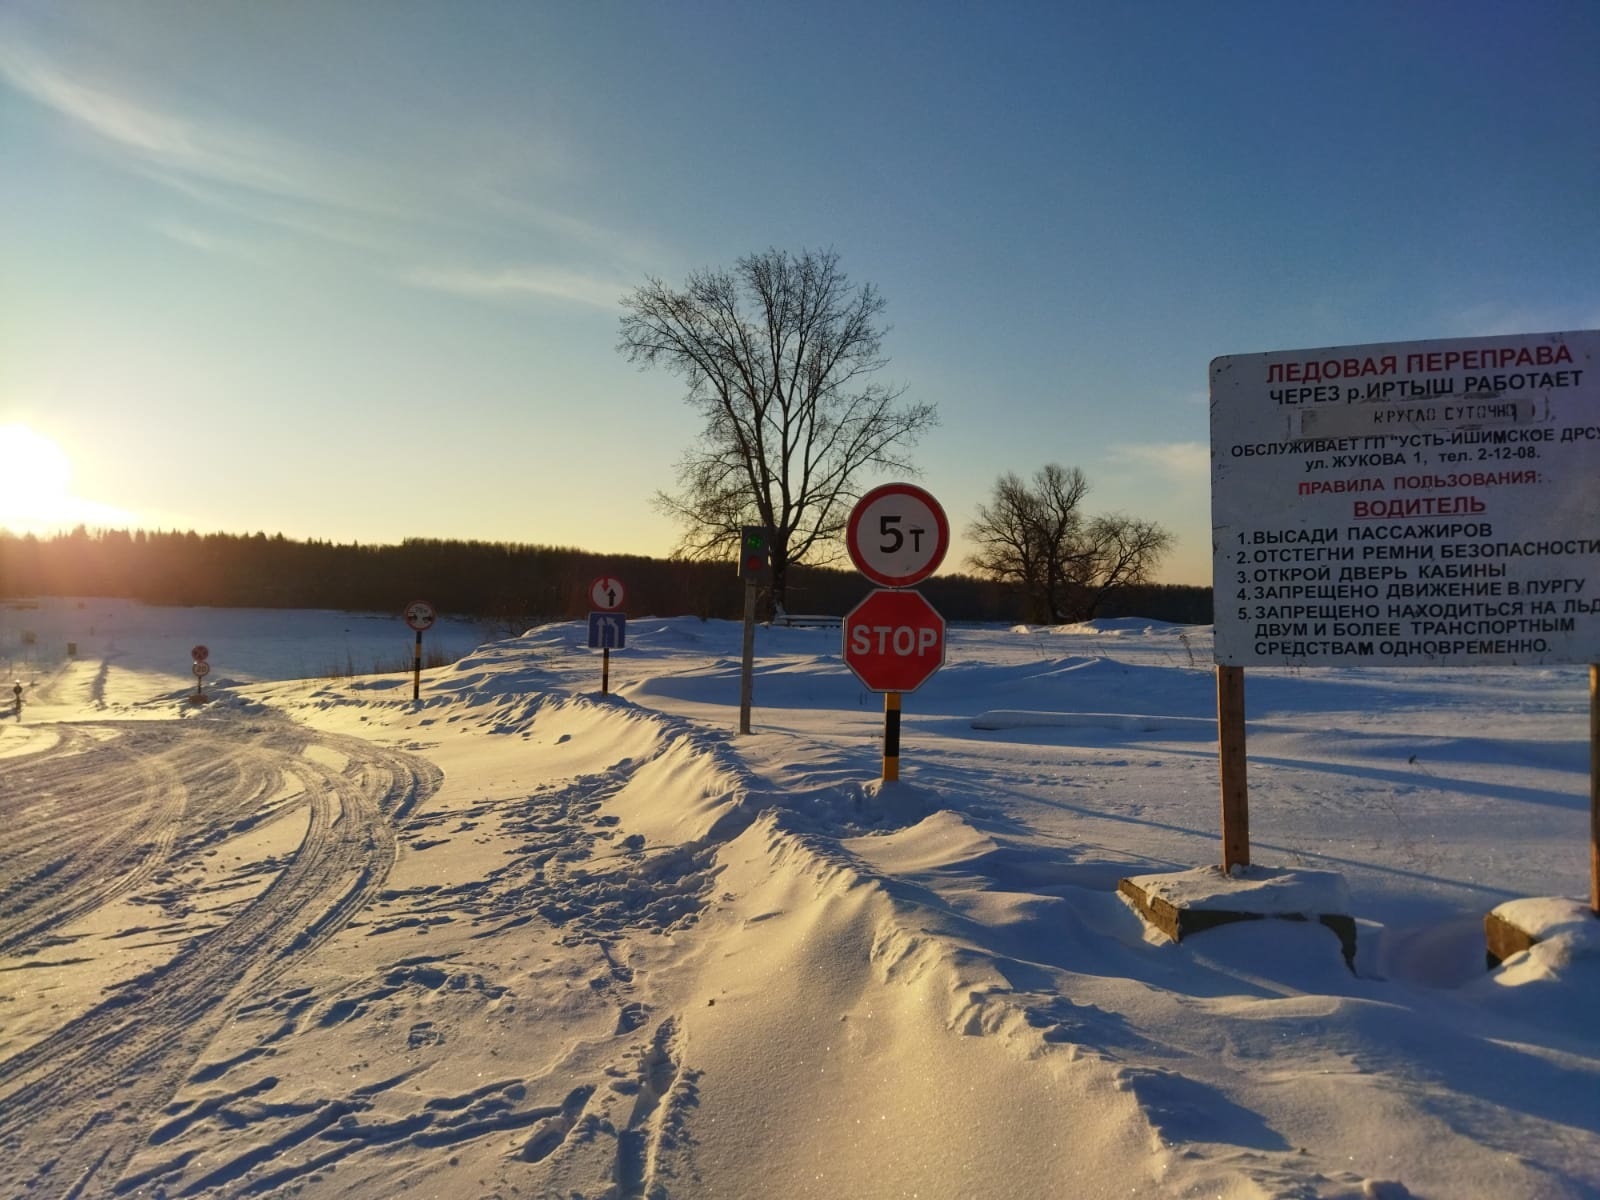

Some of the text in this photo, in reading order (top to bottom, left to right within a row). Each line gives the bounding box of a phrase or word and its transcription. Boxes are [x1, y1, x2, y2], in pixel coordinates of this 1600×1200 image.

[1266, 344, 1573, 384] ЛЕДОВАЯ ПЕРЕПРАВА
[1270, 385, 1340, 404] ЧЕРЕЗ
[1464, 370, 1583, 393] РАБОТАЕТ
[1231, 438, 1357, 457] ОБСЛУЖИВАЕТ
[1440, 452, 1472, 463] тел.
[1478, 446, 1541, 461] 2-12-08.
[1298, 471, 1543, 496] ПРАВИЛА ПОЛЬЗОВАНИЯ:
[1354, 496, 1486, 519] ВОДИТЕЛЬ
[1348, 523, 1492, 540] ПАССАЖИРОВ
[1363, 545, 1433, 560] РЕМНИ
[1441, 540, 1600, 558] БЕЗОПАСНОСТИ
[1339, 566, 1407, 583] ДВЕРЬ
[1419, 563, 1506, 578] КАБИНЫ
[1386, 582, 1502, 599] ДВИЖЕНИЕ
[1508, 581, 1520, 595] В
[1526, 578, 1585, 595] ПУРГУ
[1388, 602, 1523, 620] НАХОДИТЬСЯ
[1531, 600, 1556, 615] НА
[1255, 617, 1574, 638] ДВУМ И БОЛЕЕ ТРАНСПОРТНЫМ
[851, 624, 938, 657] STOP
[1255, 638, 1552, 657] СРЕДСТВАМ ОДНОВРЕМЕННО.
